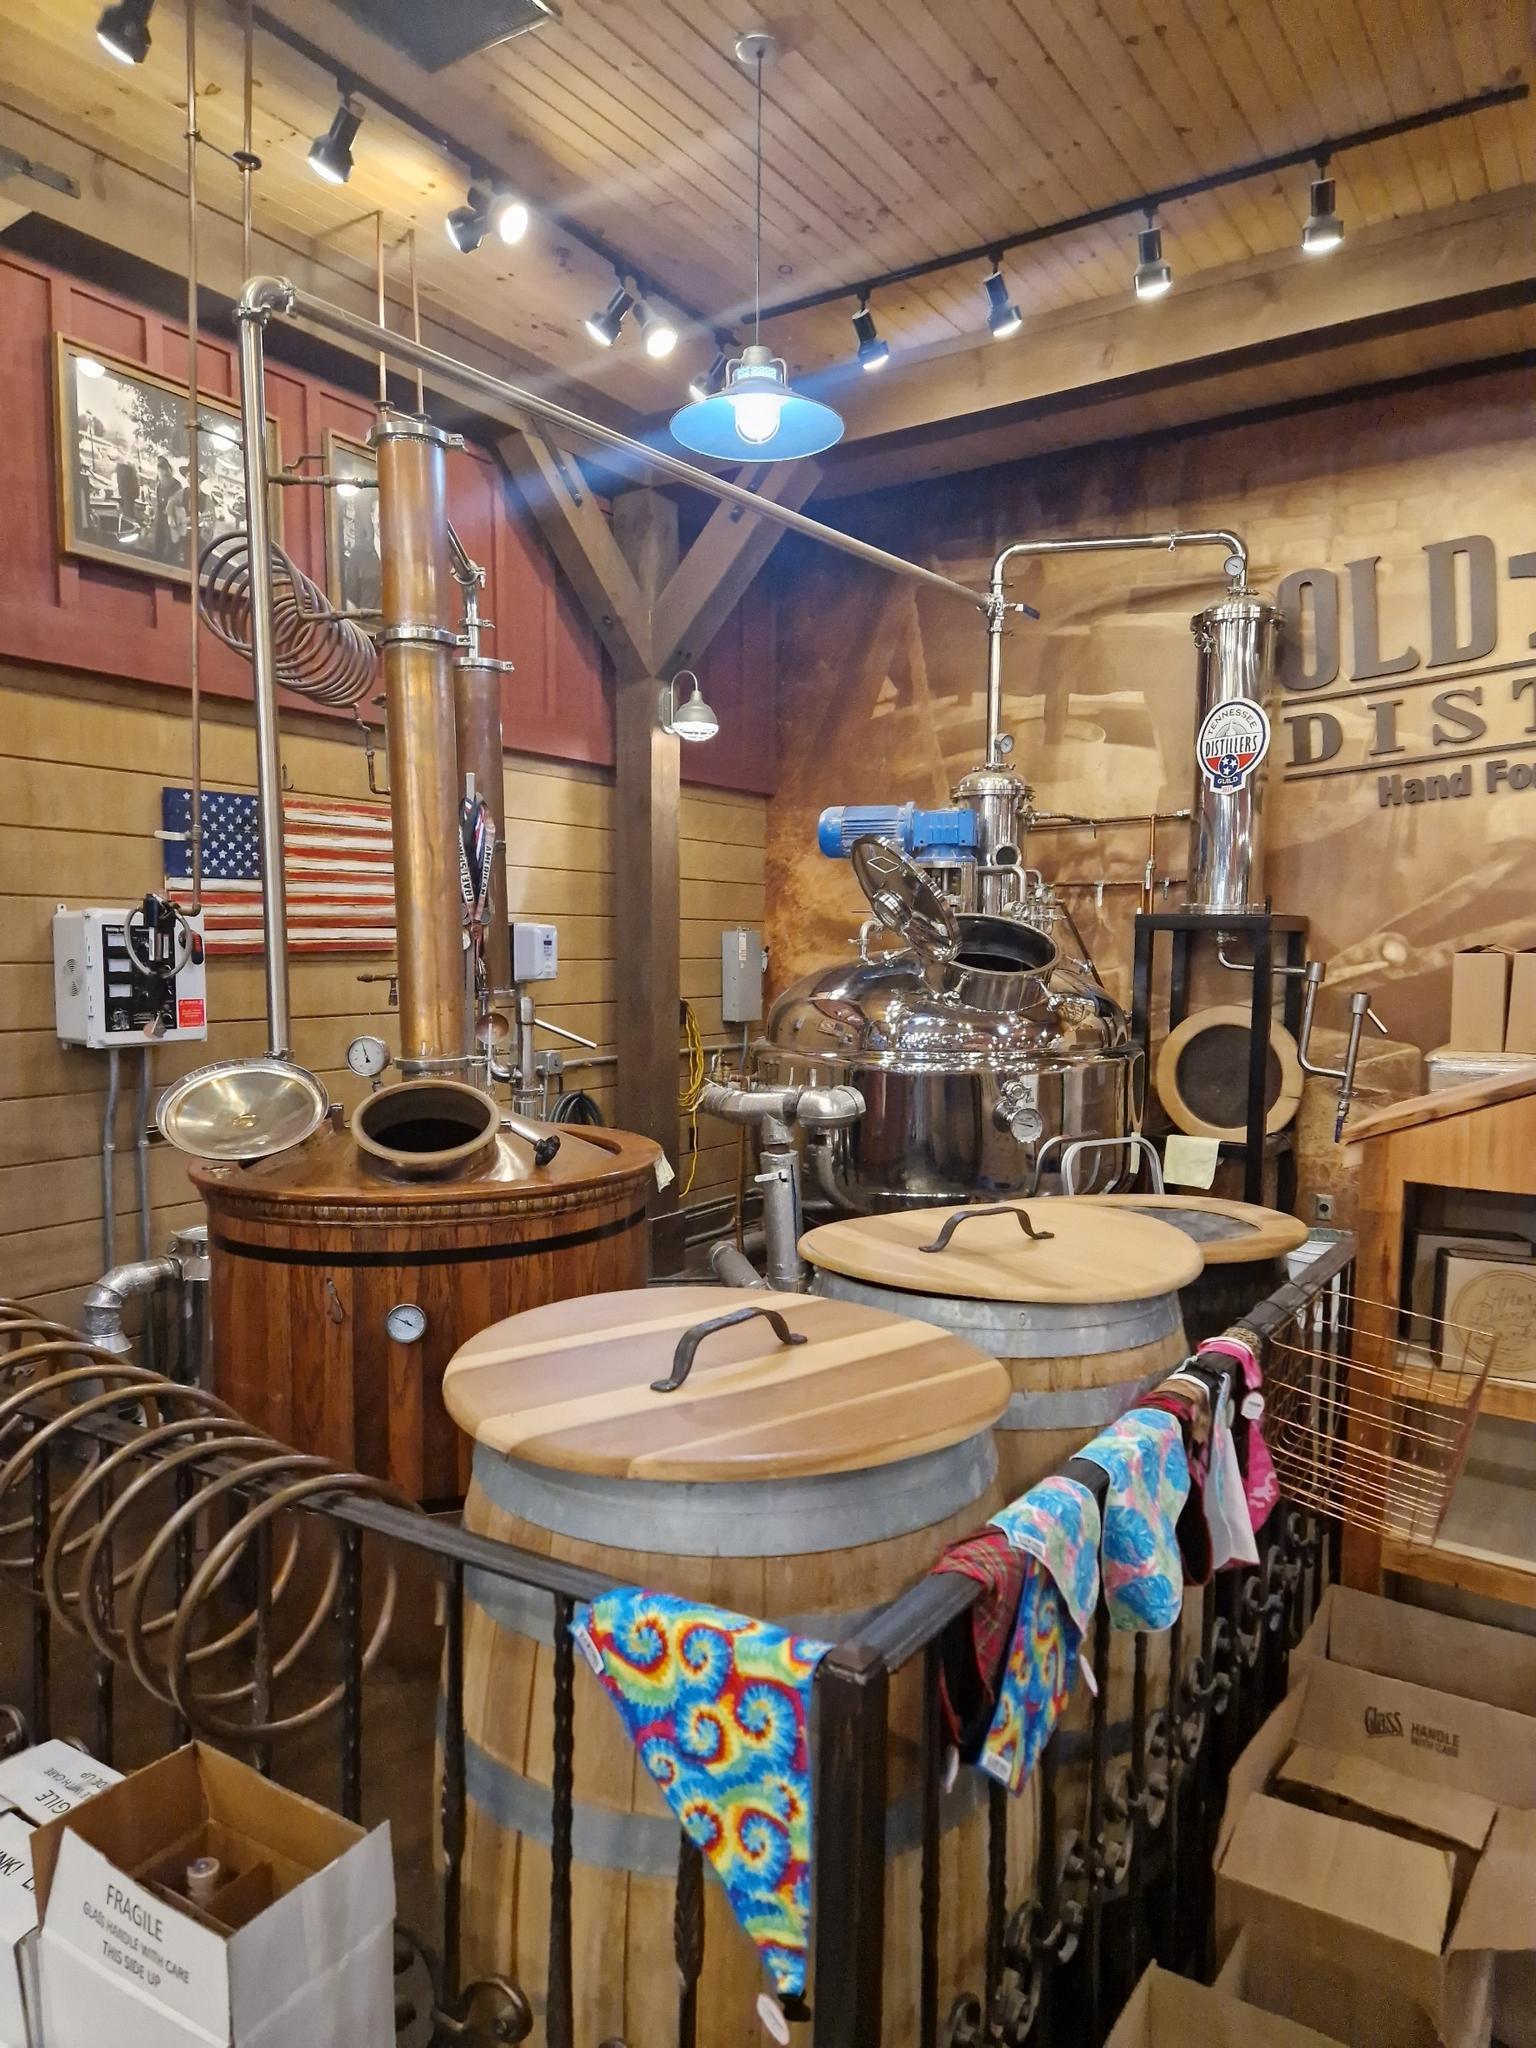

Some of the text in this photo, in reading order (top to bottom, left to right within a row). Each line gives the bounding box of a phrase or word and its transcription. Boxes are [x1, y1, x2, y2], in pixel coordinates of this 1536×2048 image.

[1278, 534, 1498, 691] OLD
[1205, 735, 1258, 757] DISTILLERS
[1207, 709, 1258, 736] TENNESSEE
[1378, 759, 1536, 807] Hand Fo
[1411, 1722, 1460, 1747] HANDLE
[106, 1884, 163, 1942] FRAGILE
[83, 1901, 105, 1928] GLASS
[106, 1920, 139, 1951] HANDLE
[165, 1959, 190, 1984] CARE
[103, 1939, 161, 1986] THIS SIDE UP
